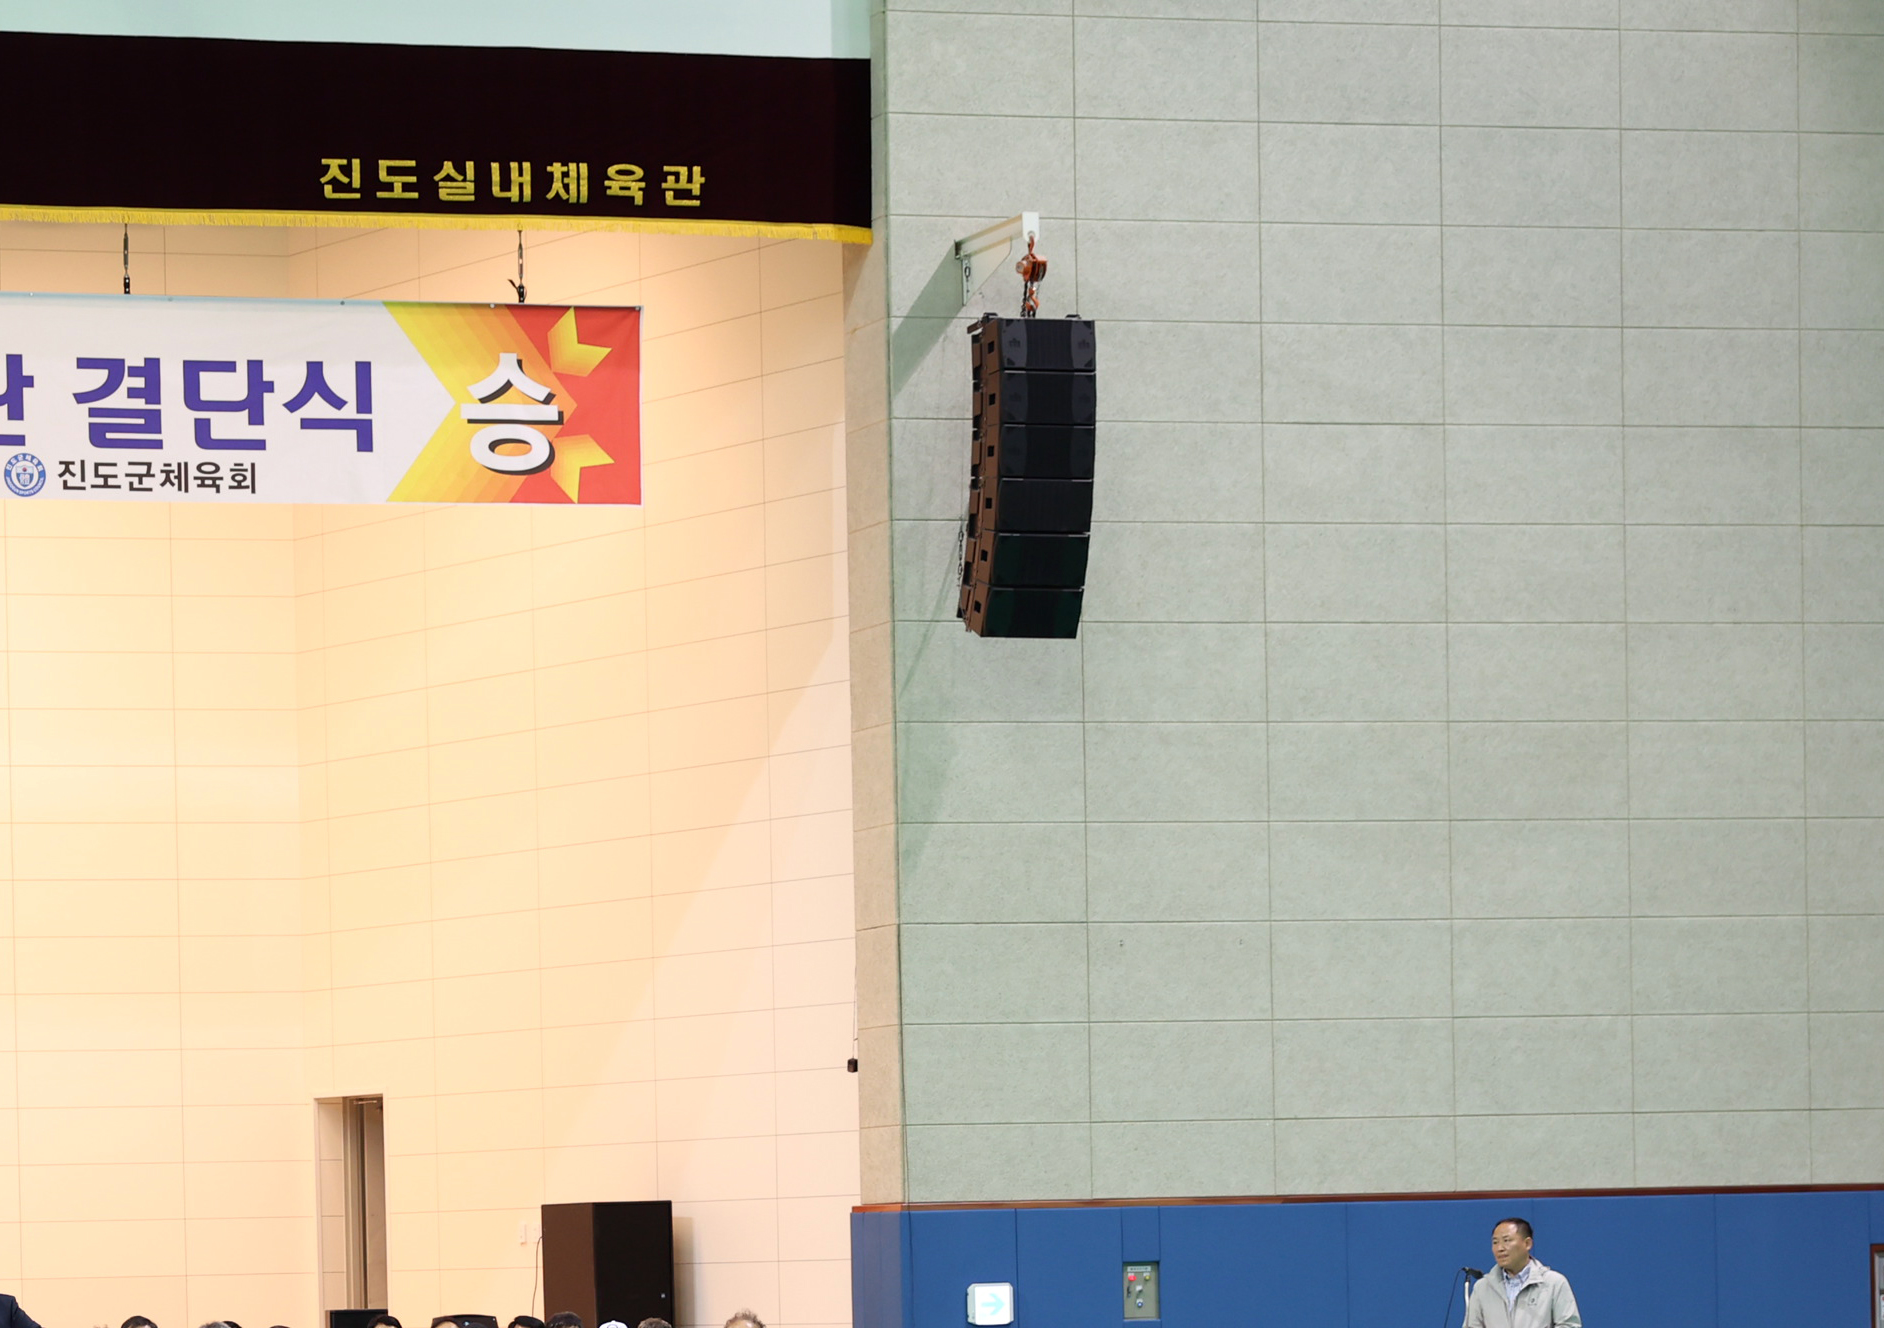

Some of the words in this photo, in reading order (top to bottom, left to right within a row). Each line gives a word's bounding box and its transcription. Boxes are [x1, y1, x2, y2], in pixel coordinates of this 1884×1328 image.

[319, 158, 706, 206] 진도실내체육관
[72, 357, 374, 452] 결단식
[460, 353, 564, 475] 승
[57, 459, 257, 494] 진도군체육회
